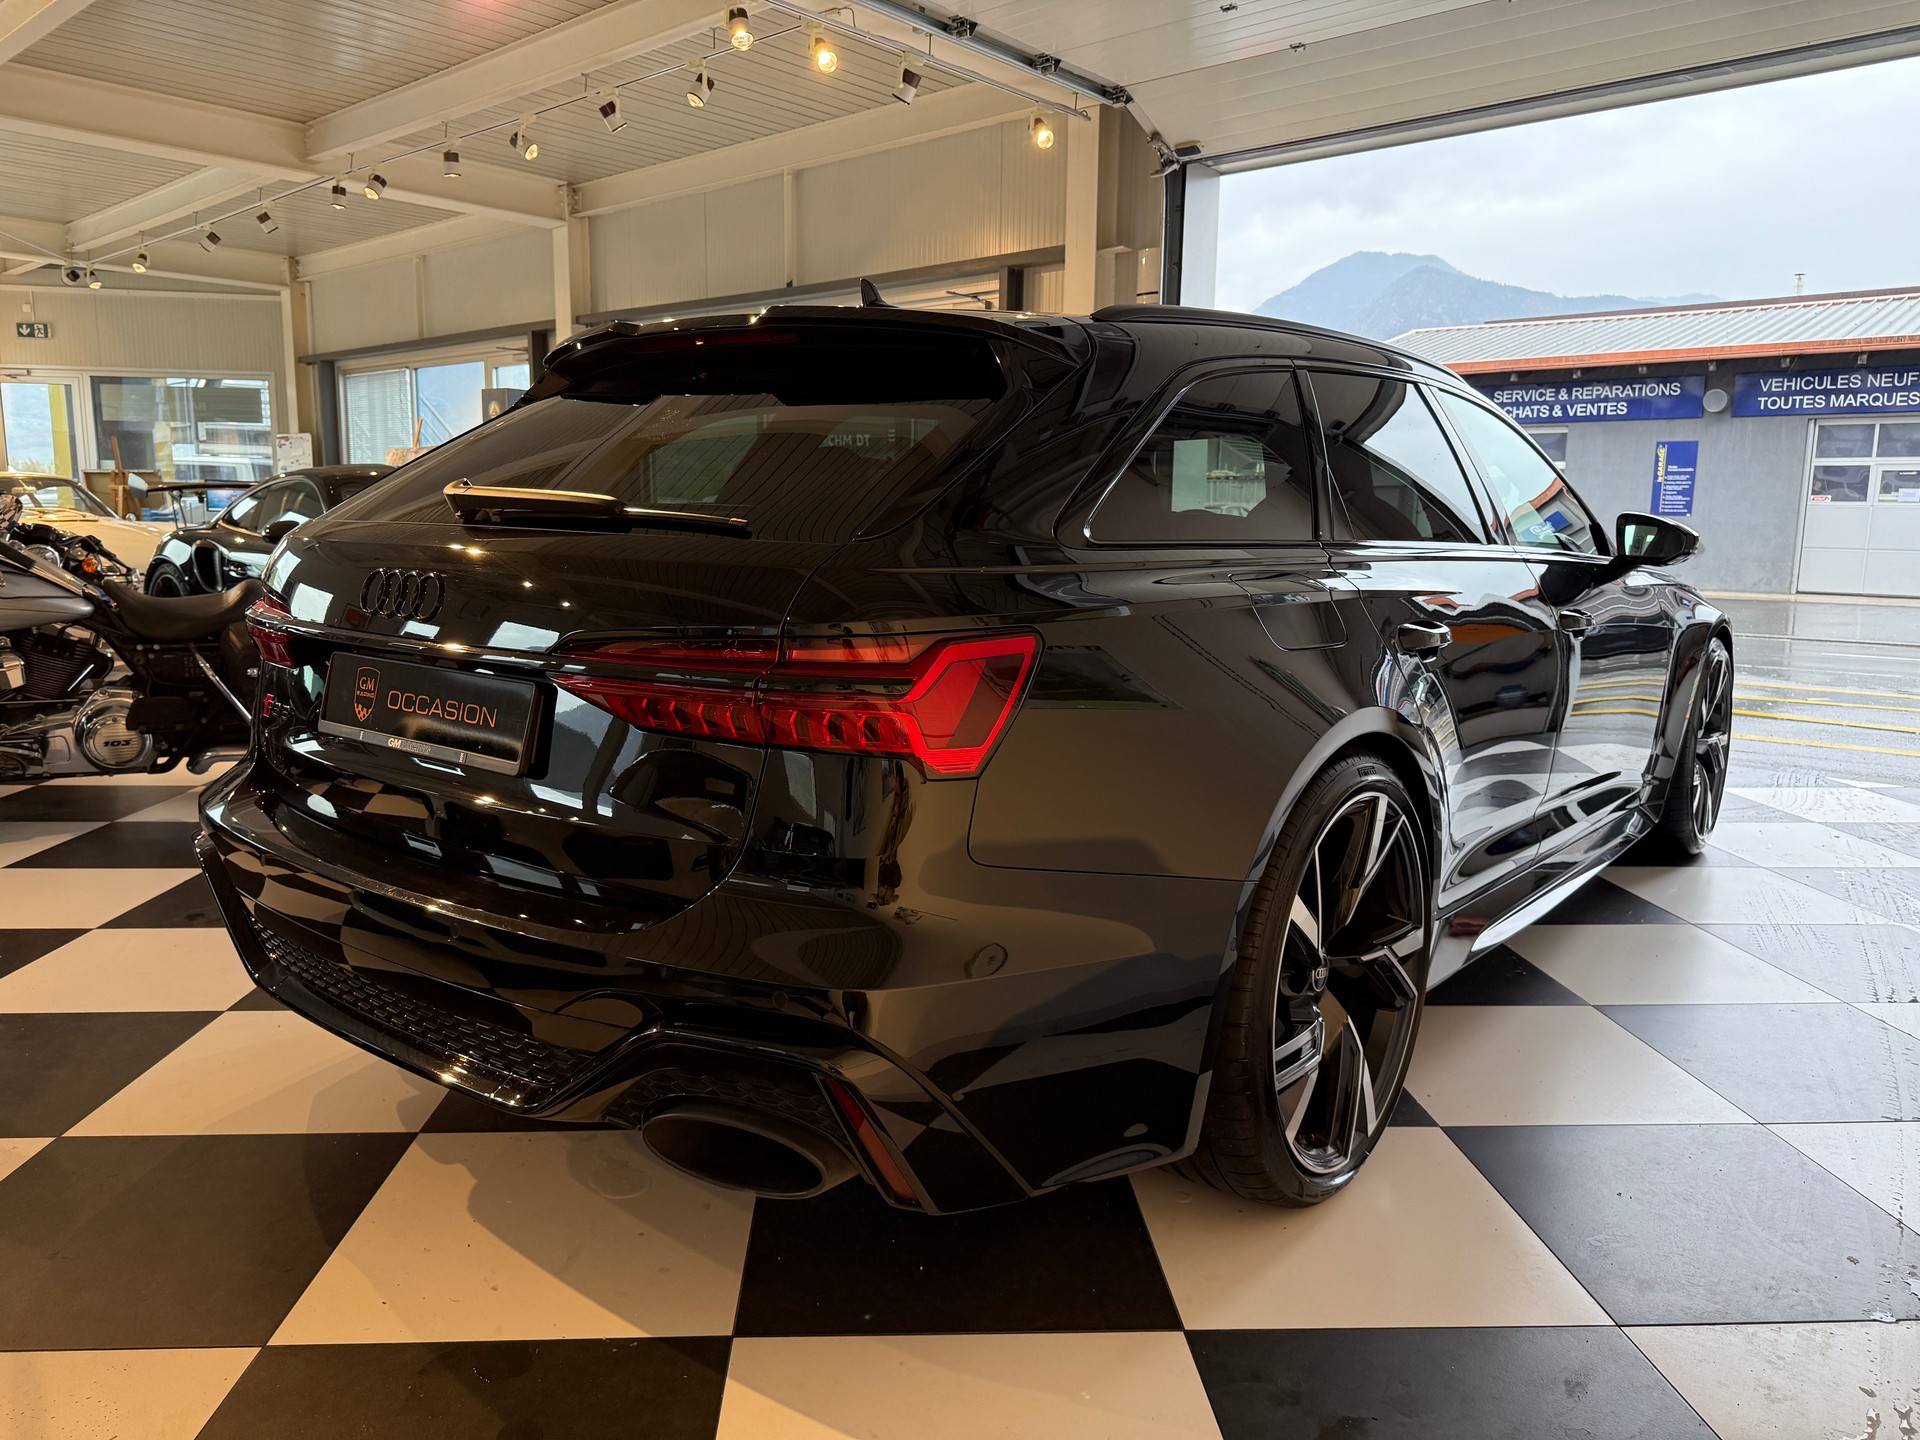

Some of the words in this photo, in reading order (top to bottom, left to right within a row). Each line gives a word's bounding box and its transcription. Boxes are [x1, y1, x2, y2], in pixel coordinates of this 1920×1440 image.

[1759, 374, 1862, 392] VEHICULES
[1867, 371, 1920, 389] NEUF
[1493, 388, 1556, 403] SERVICE
[1558, 387, 1569, 401] &
[1571, 382, 1681, 400] REPARATIONS
[1757, 394, 1826, 410] TOUTES
[1829, 391, 1920, 408] MARQUES
[1502, 404, 1550, 418] CHATS
[1551, 404, 1563, 418] &
[1566, 402, 1628, 417] VENTES
[359, 676, 375, 691] GM
[387, 690, 498, 728] OCCASION
[103, 739, 132, 747] 103
